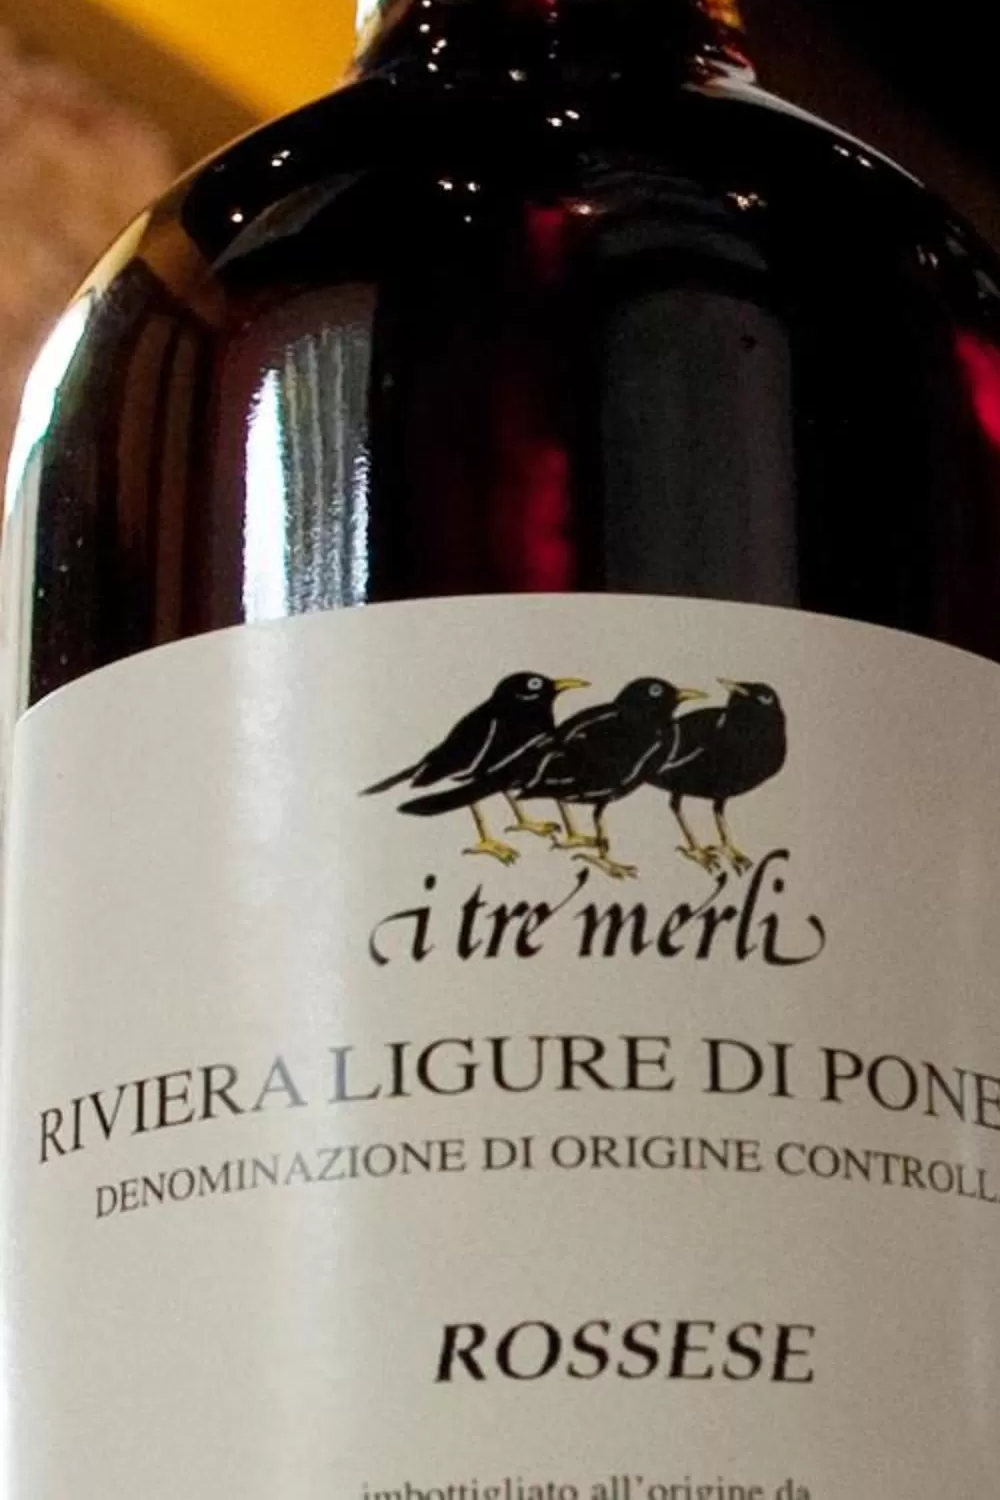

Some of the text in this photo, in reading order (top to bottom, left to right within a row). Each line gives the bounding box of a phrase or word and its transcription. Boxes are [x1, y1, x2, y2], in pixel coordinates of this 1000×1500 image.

[369, 873, 436, 966] i
[577, 848, 826, 967] merli
[38, 1055, 308, 1164] RIVIERA
[328, 1035, 676, 1104] LIGURE
[702, 1037, 794, 1098] DI
[95, 1137, 466, 1220] DENOMINAZIONE
[483, 1135, 536, 1172] DI
[550, 1135, 762, 1173] ORIGINE
[434, 1320, 817, 1384] ROSSESE
[776, 1478, 811, 1500] da
